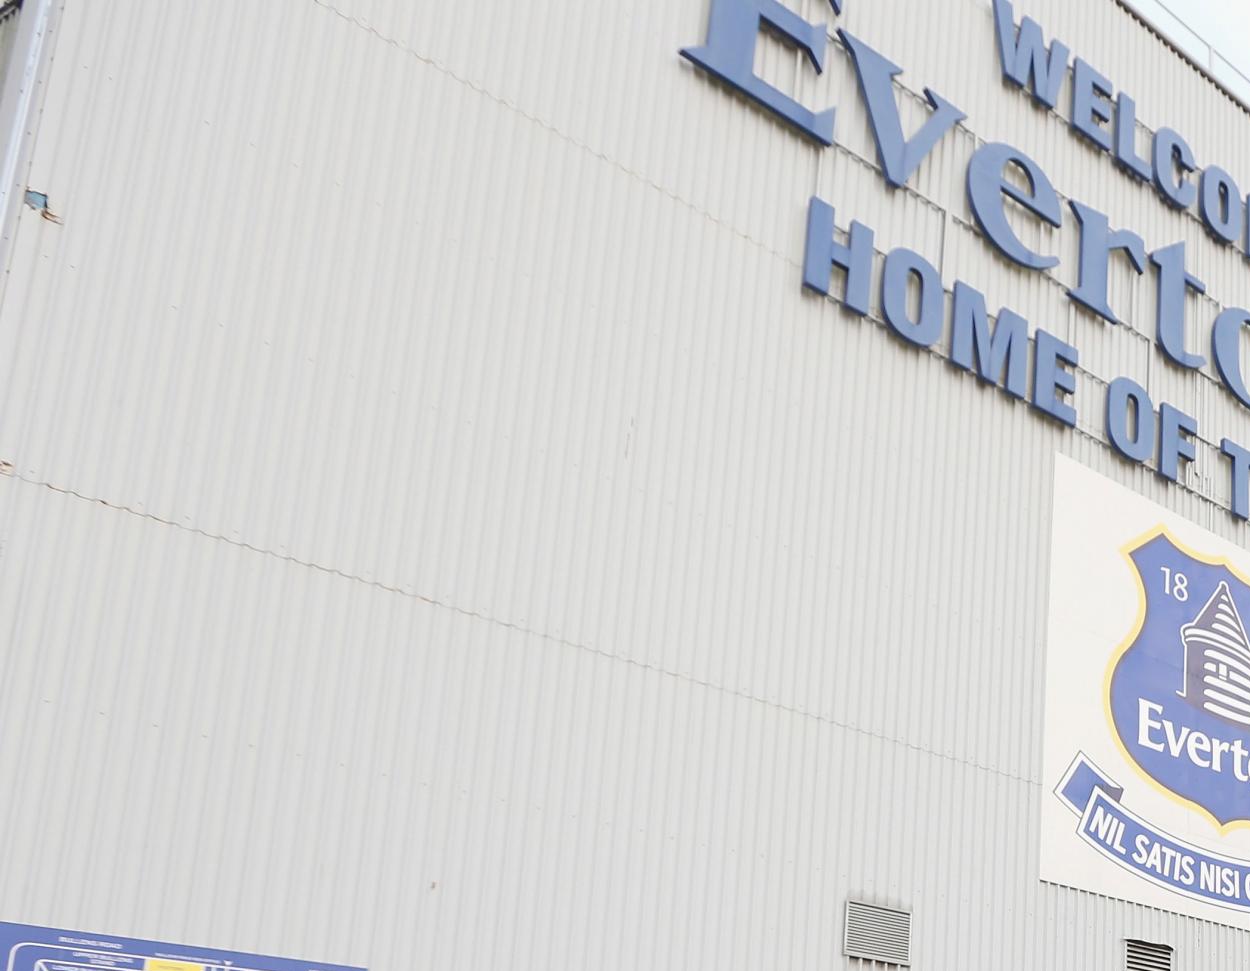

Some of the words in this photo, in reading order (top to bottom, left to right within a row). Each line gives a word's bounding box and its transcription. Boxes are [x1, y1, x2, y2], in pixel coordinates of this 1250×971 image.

[802, 195, 1079, 428] HOME
[1106, 376, 1198, 482] OF
[1159, 566, 1190, 603] 18
[1089, 805, 1128, 856] NIL
[1130, 833, 1196, 885] SATIS
[1199, 861, 1240, 899] NISI
